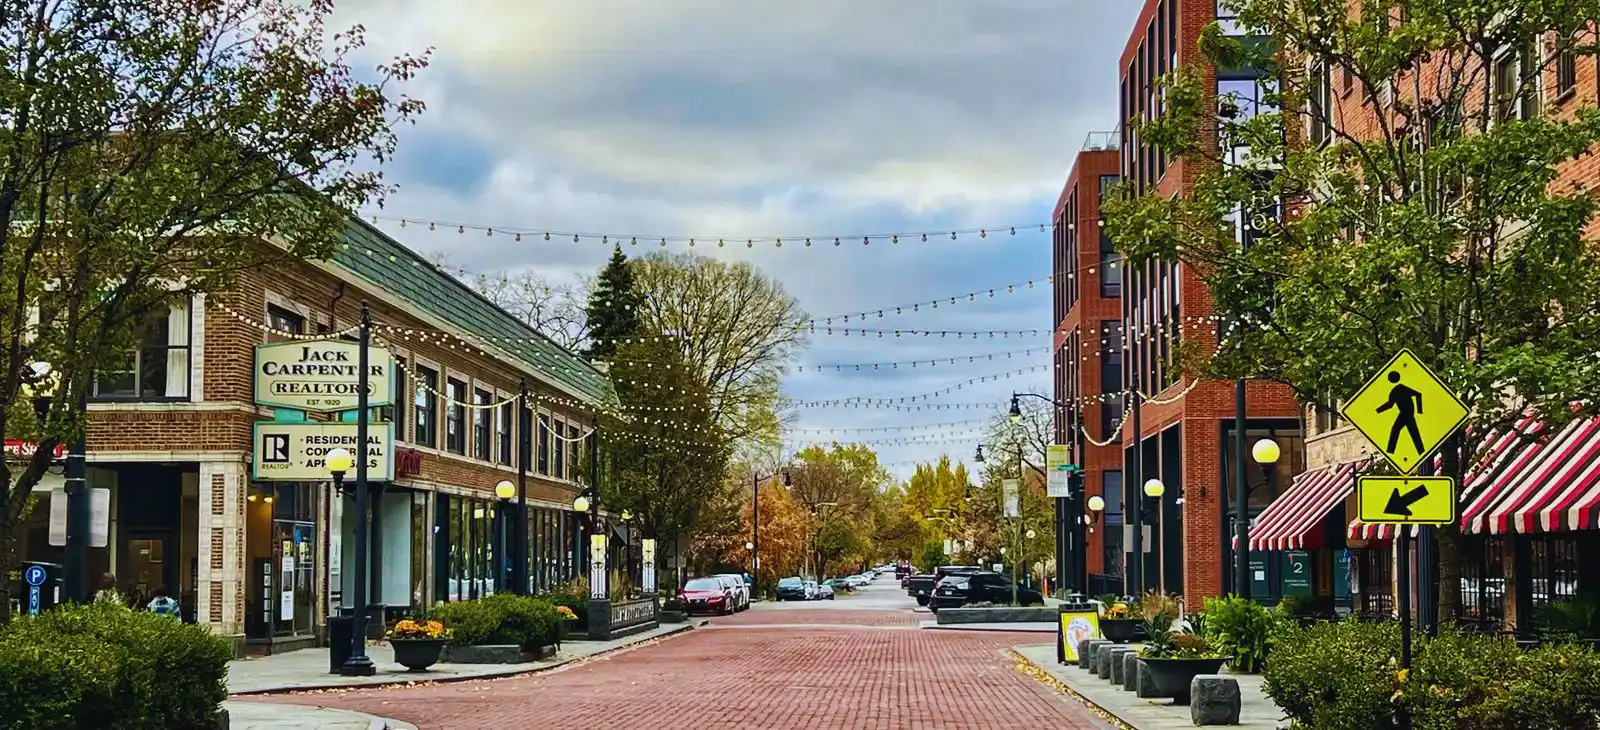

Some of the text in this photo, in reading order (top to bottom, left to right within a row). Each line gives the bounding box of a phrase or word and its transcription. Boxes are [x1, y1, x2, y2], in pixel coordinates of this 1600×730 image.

[262, 361, 384, 376] CARPENTR
[305, 436, 381, 445] RESIDENAL
[306, 447, 383, 456] COMRAL
[1293, 562, 1304, 574] 2
[32, 569, 42, 582] P
[31, 588, 39, 607] PAY
